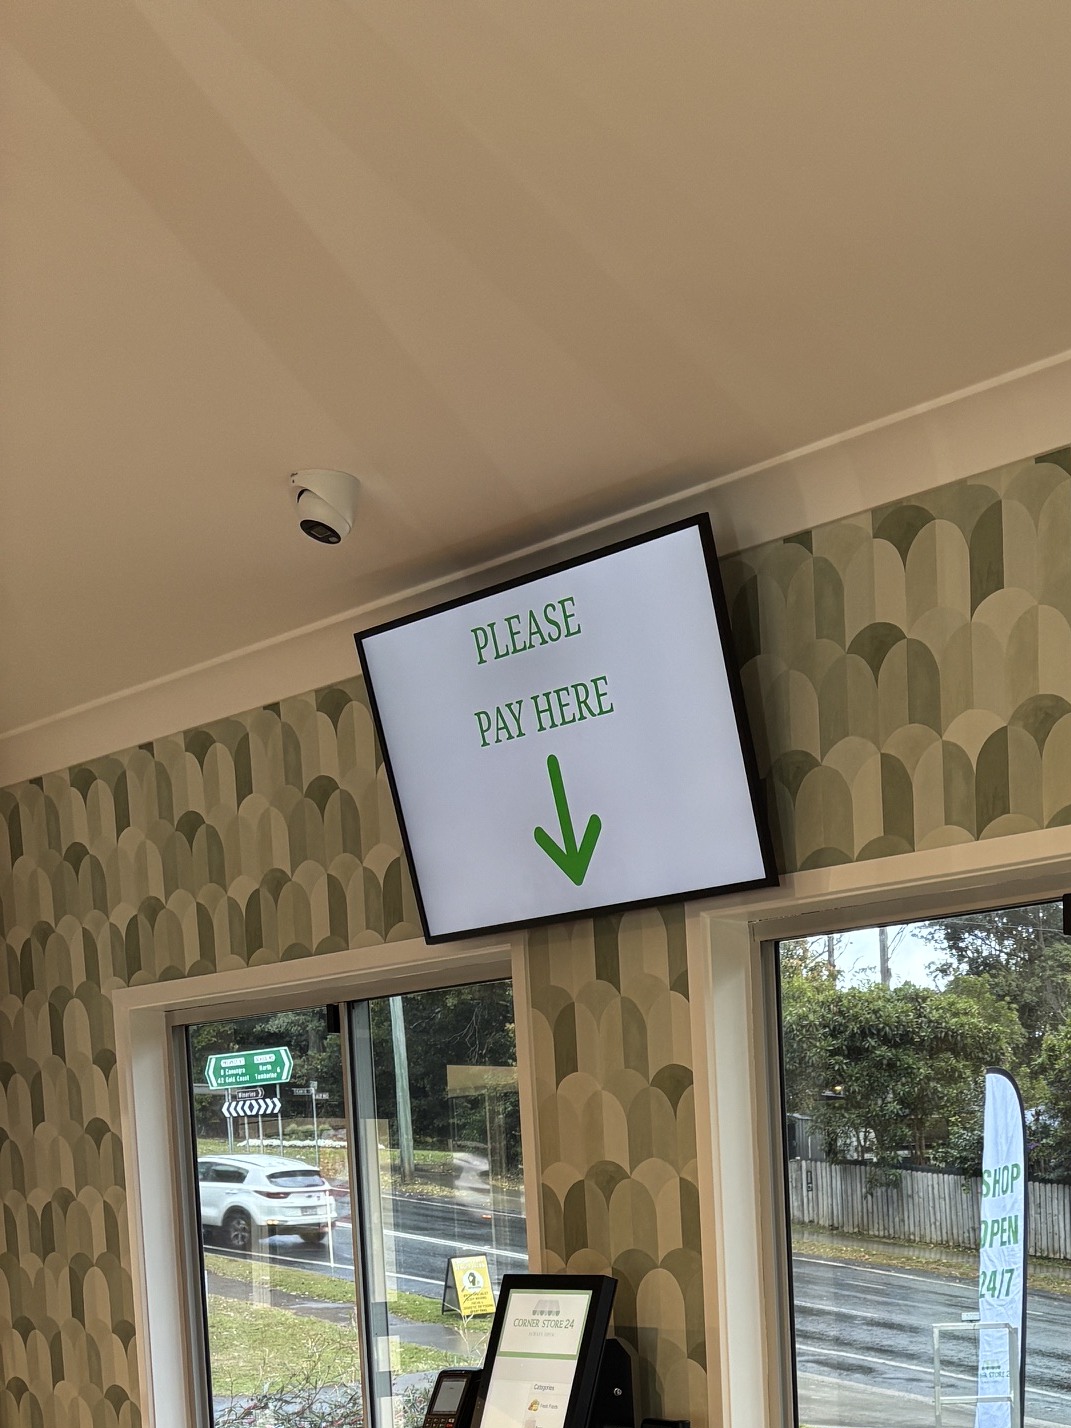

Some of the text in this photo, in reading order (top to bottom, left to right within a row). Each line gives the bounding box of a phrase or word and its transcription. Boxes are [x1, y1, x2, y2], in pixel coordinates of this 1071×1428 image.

[471, 596, 581, 665] PLEASE
[474, 676, 614, 747] PAY HERE
[982, 1163, 1020, 1198] SHOP
[979, 1268, 1015, 1299] 24/7
[513, 1318, 575, 1329] CORNER STORE 24
